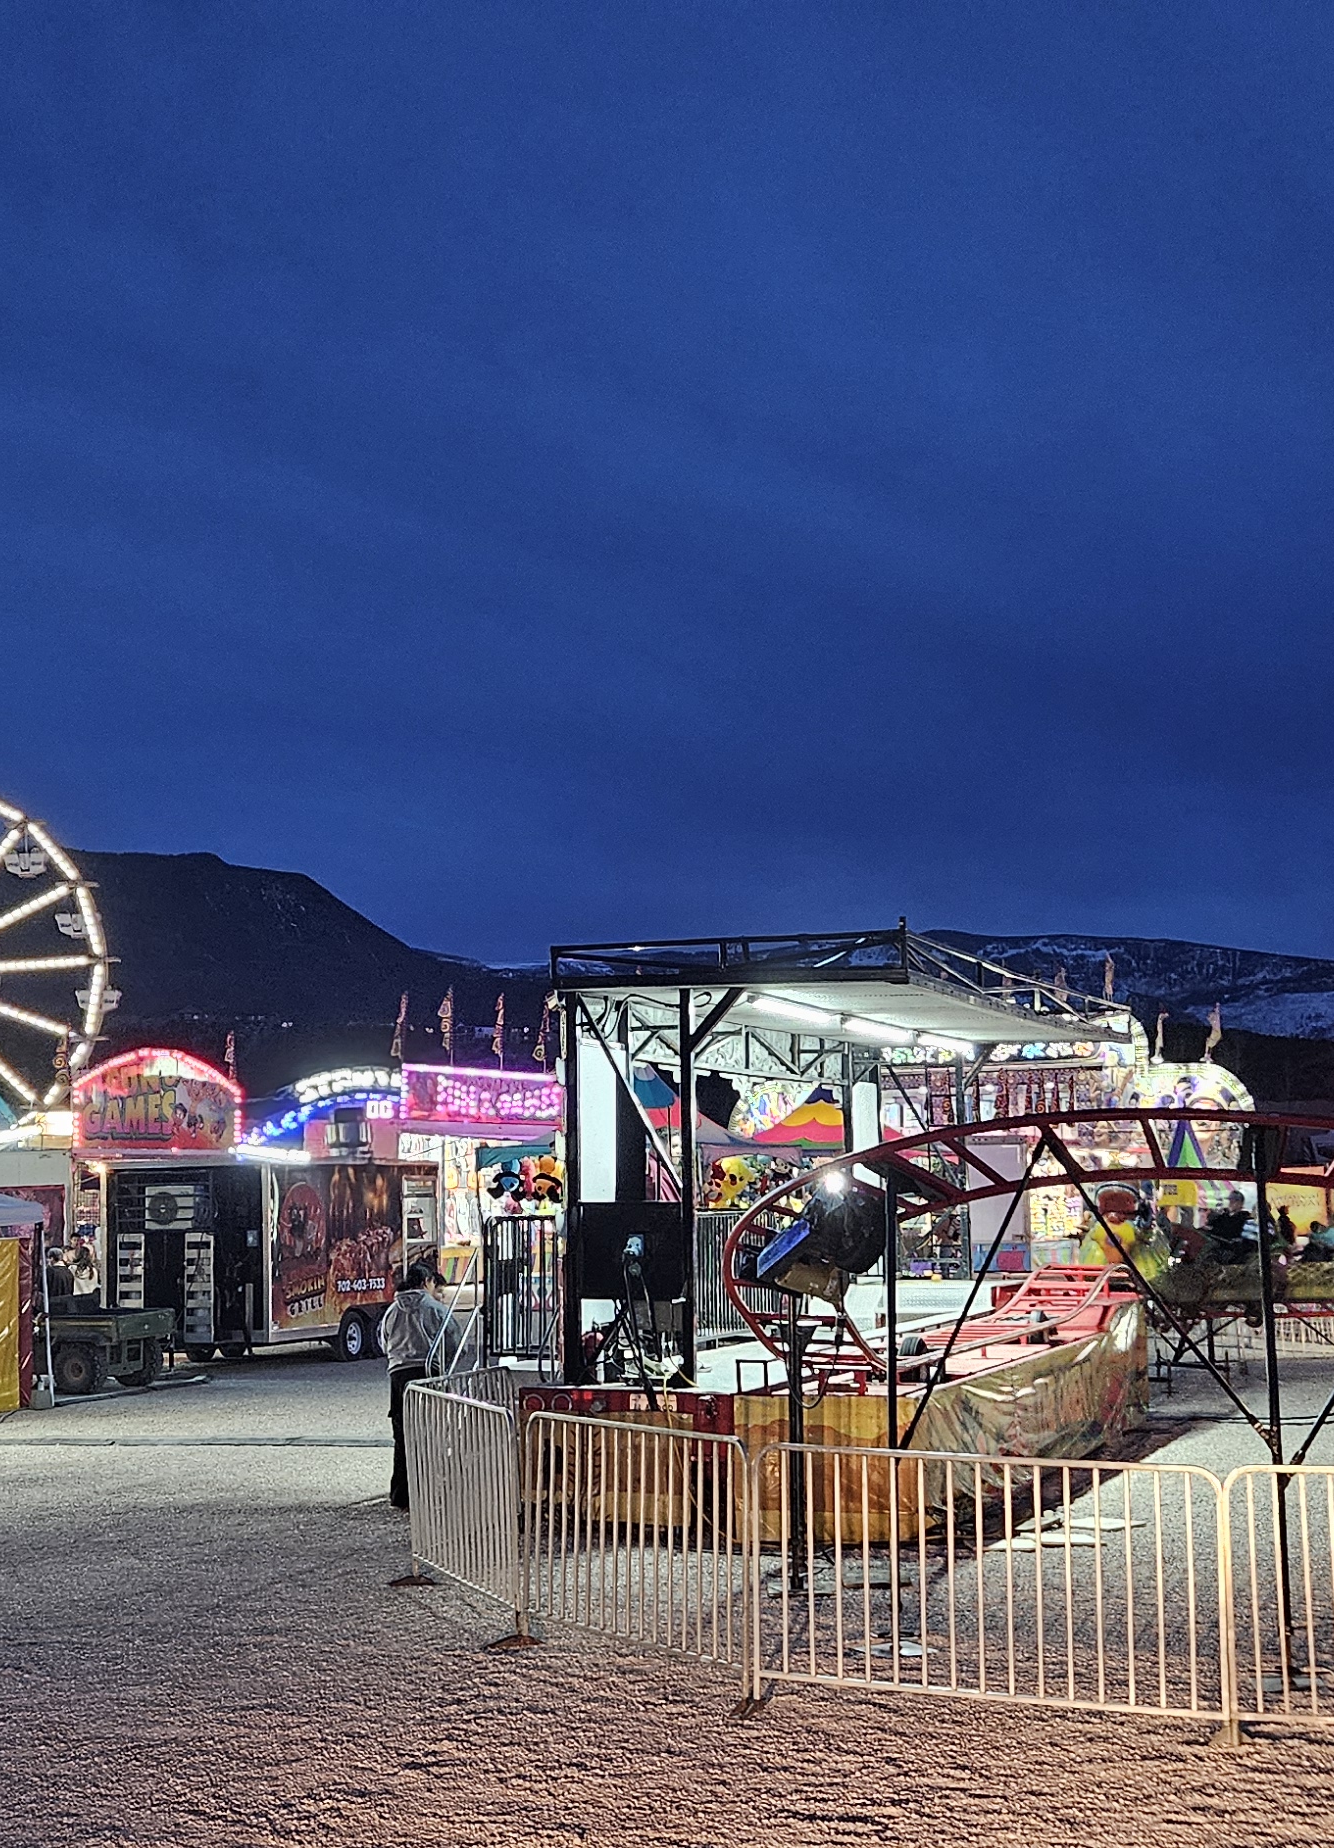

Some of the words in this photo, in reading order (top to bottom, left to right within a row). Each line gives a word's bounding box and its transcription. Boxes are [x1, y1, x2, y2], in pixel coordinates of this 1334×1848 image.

[83, 1090, 176, 1137] GAMES
[285, 1274, 326, 1300] SMOKIN
[287, 1293, 325, 1318] GRILL
